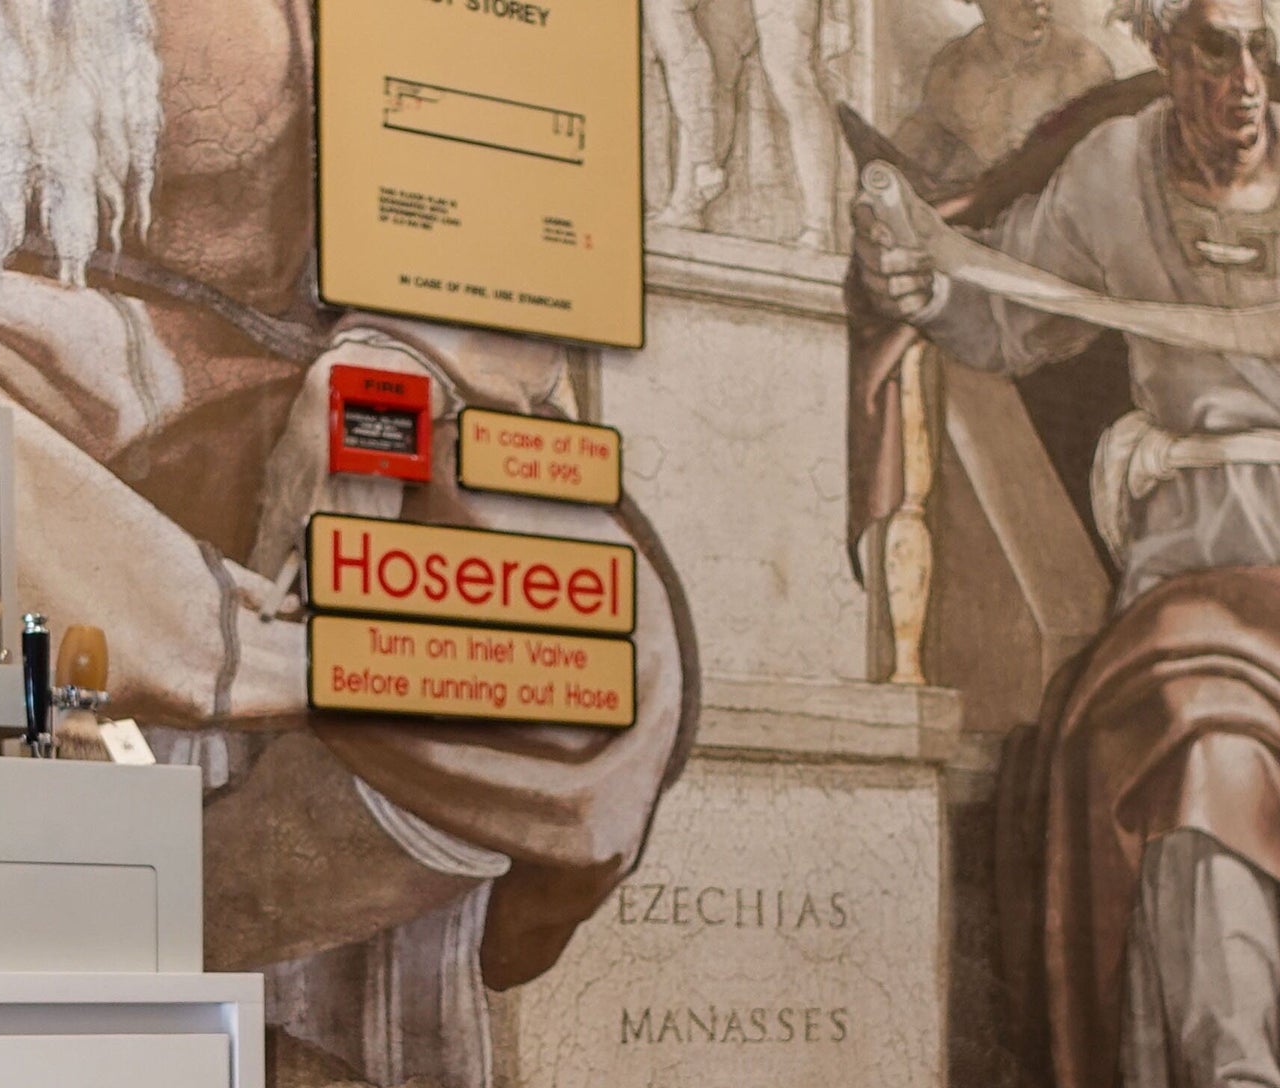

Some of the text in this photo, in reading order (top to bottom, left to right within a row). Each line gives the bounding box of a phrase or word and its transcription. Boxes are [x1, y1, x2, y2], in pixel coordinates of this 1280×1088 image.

[414, 276, 443, 290] CASE
[447, 281, 460, 293] OF
[495, 289, 513, 301] USE
[518, 291, 572, 311] STAIRCASE
[363, 378, 405, 396] FIRE
[474, 423, 610, 461] In case of Fire
[503, 457, 582, 485] Call 995
[332, 529, 619, 617] Hosereel
[368, 626, 588, 669] Turn on Inlet Valve
[331, 665, 619, 710] Before running out Hose
[619, 883, 847, 929] EZECHIAS
[620, 1004, 849, 1045] MANASSES
